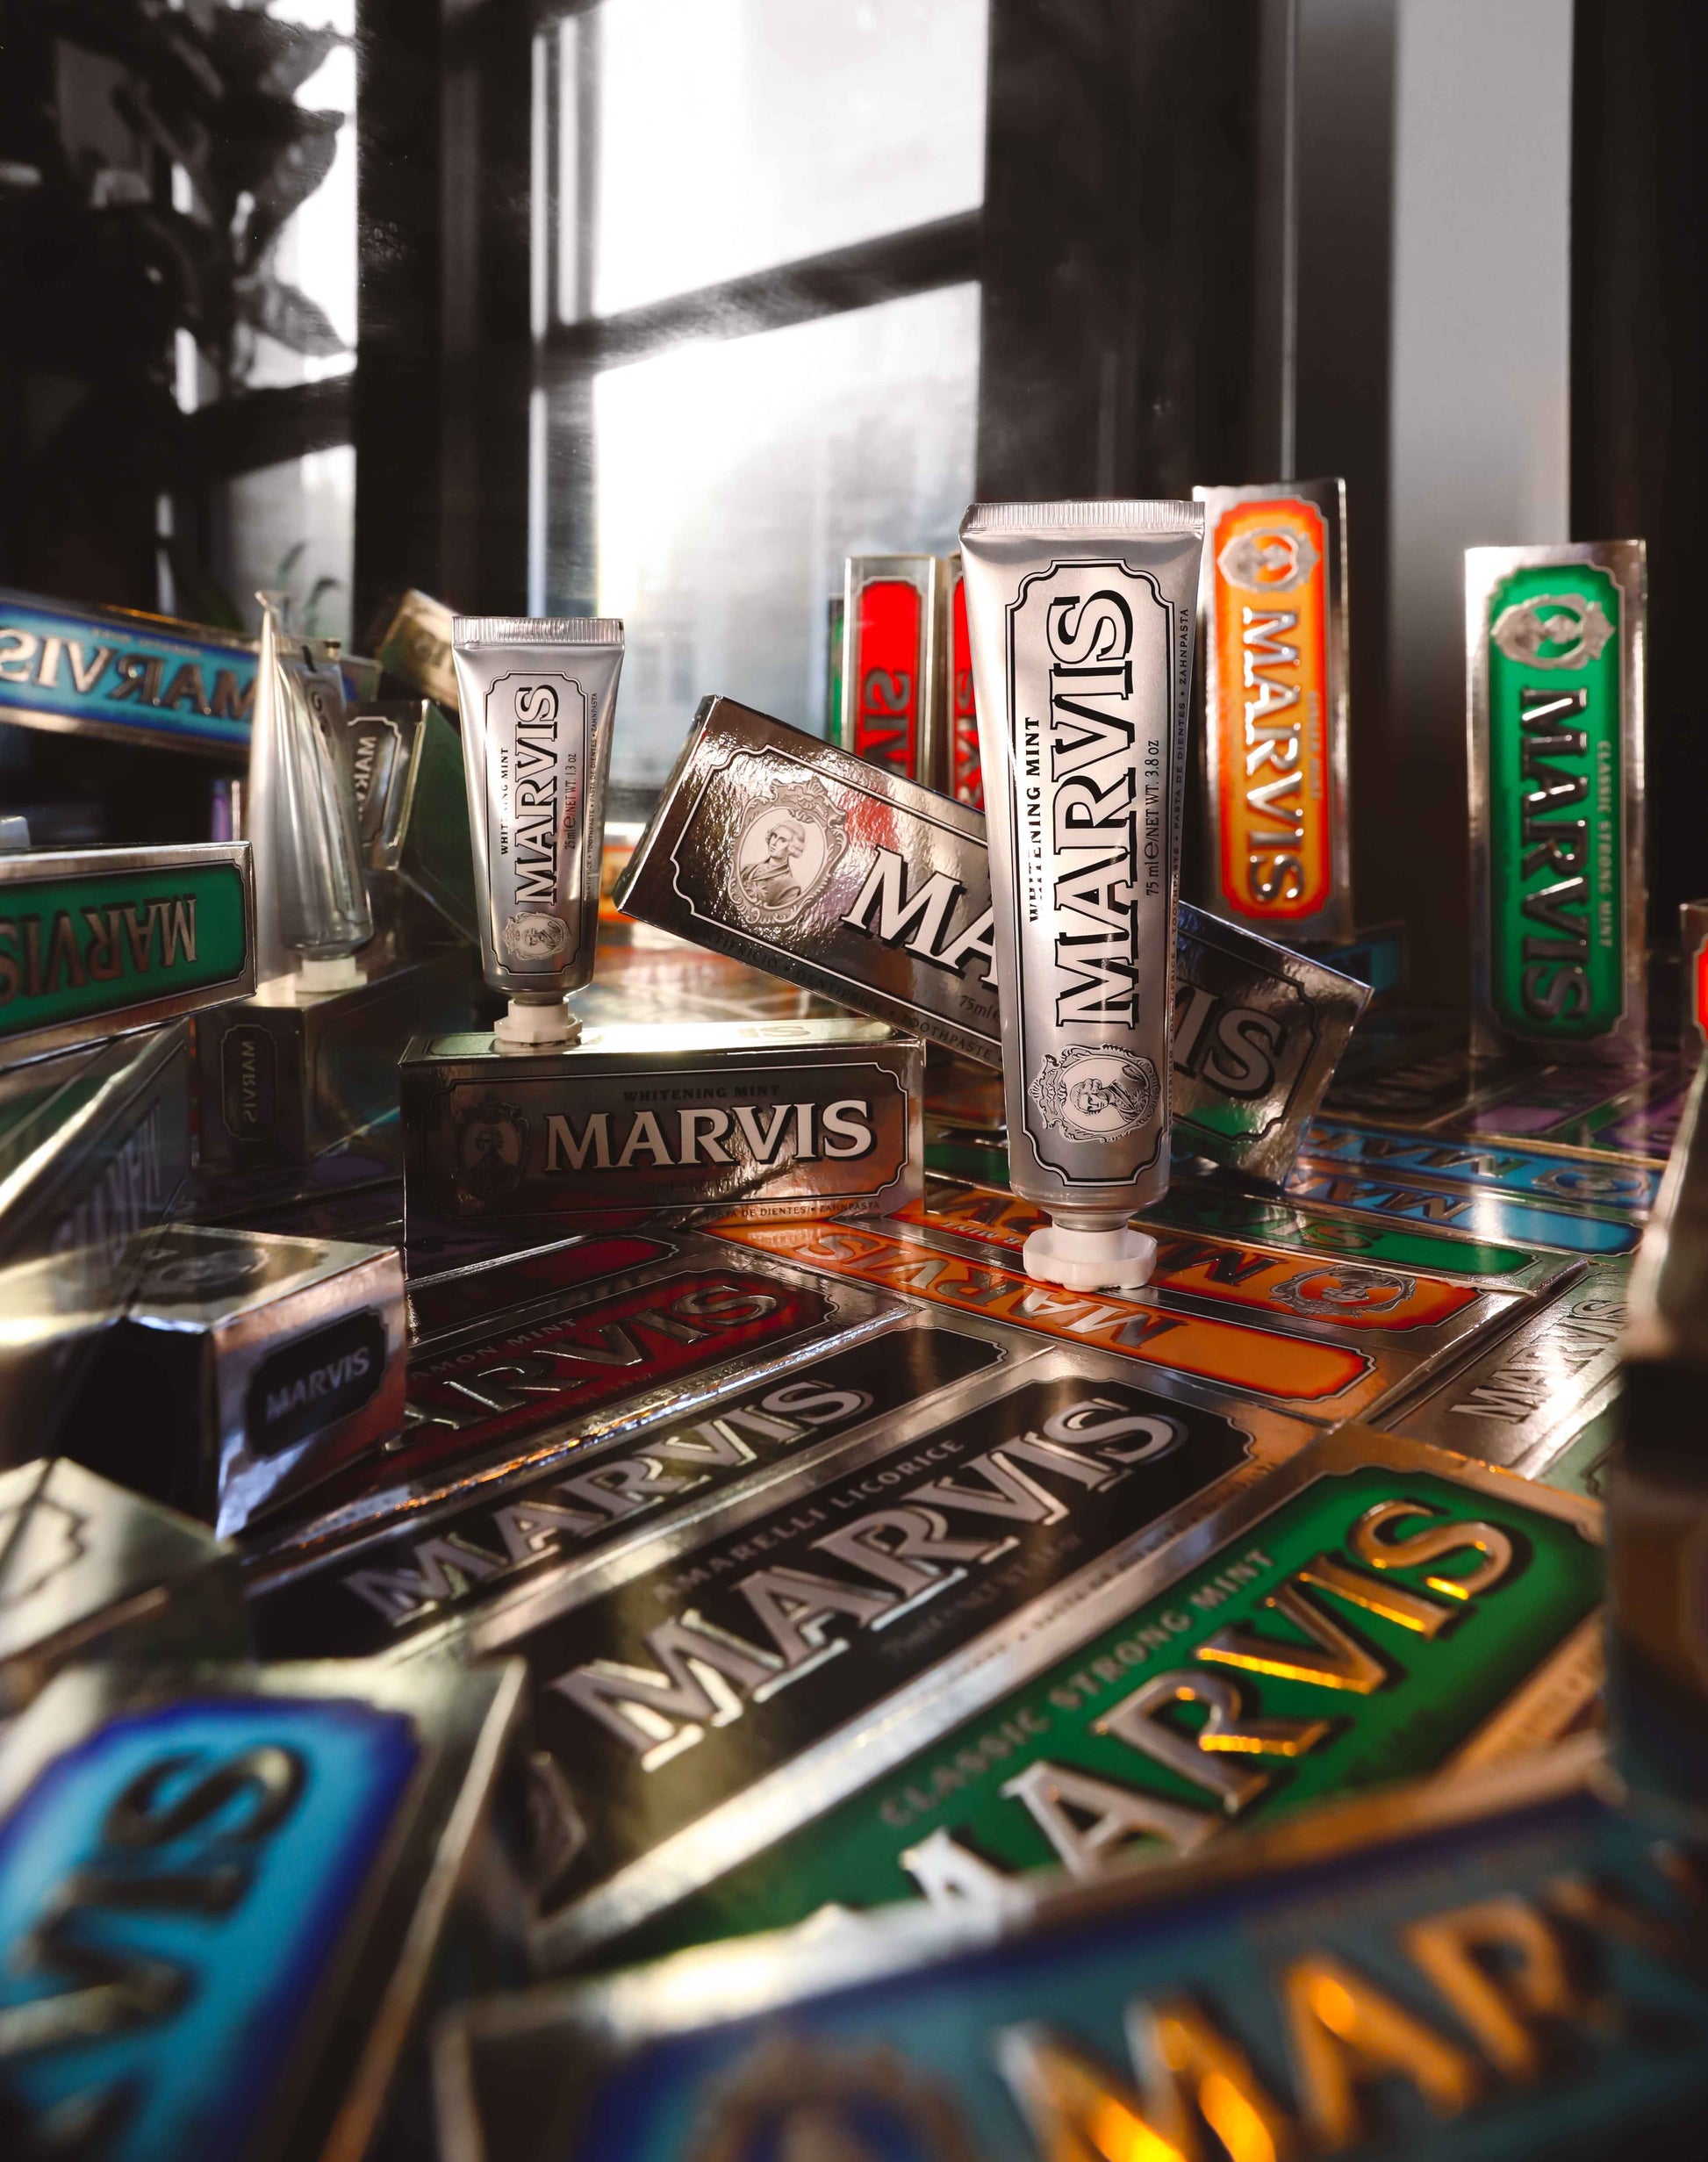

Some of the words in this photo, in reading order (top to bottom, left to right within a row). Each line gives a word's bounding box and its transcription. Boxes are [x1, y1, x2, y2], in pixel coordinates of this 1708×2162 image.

[1179, 607, 1189, 685] ZAHNPASTA
[1025, 717, 1041, 777] MINT
[1176, 702, 1187, 760] DIENTES
[1242, 605, 1306, 903] MARVIS
[500, 748, 509, 779] MINT
[564, 765, 576, 776] 1.3
[1145, 758, 1159, 777] 3.8
[1176, 766, 1183, 783] DE
[514, 684, 559, 906] MARVIS
[1046, 589, 1139, 1031] MARVIS
[564, 840, 576, 850] 25
[1519, 686, 1593, 1021] MARVIS
[1146, 881, 1159, 896] 75
[1598, 901, 1613, 949] MINT
[902, 1012, 993, 1060] TOOTHPASTE
[622, 1086, 727, 1103] WHITENING
[734, 1084, 780, 1099] MINT
[543, 1099, 878, 1174] MARVIS
[741, 1207, 757, 1217] DE
[759, 1205, 807, 1217] DIENTES
[819, 1201, 880, 1214] ZAHNPASTA
[939, 1221, 998, 1239] MINT
[792, 1233, 1189, 1349] MARVIS
[506, 1317, 579, 1348] MINT
[266, 1347, 371, 1419] MARVIS
[343, 1380, 874, 1627] MARVIS
[829, 1440, 965, 1510] LICORICE
[545, 1398, 1188, 1773] MARVIS
[1049, 1608, 1196, 1711] STRONG
[1189, 1546, 1278, 1617] MINT
